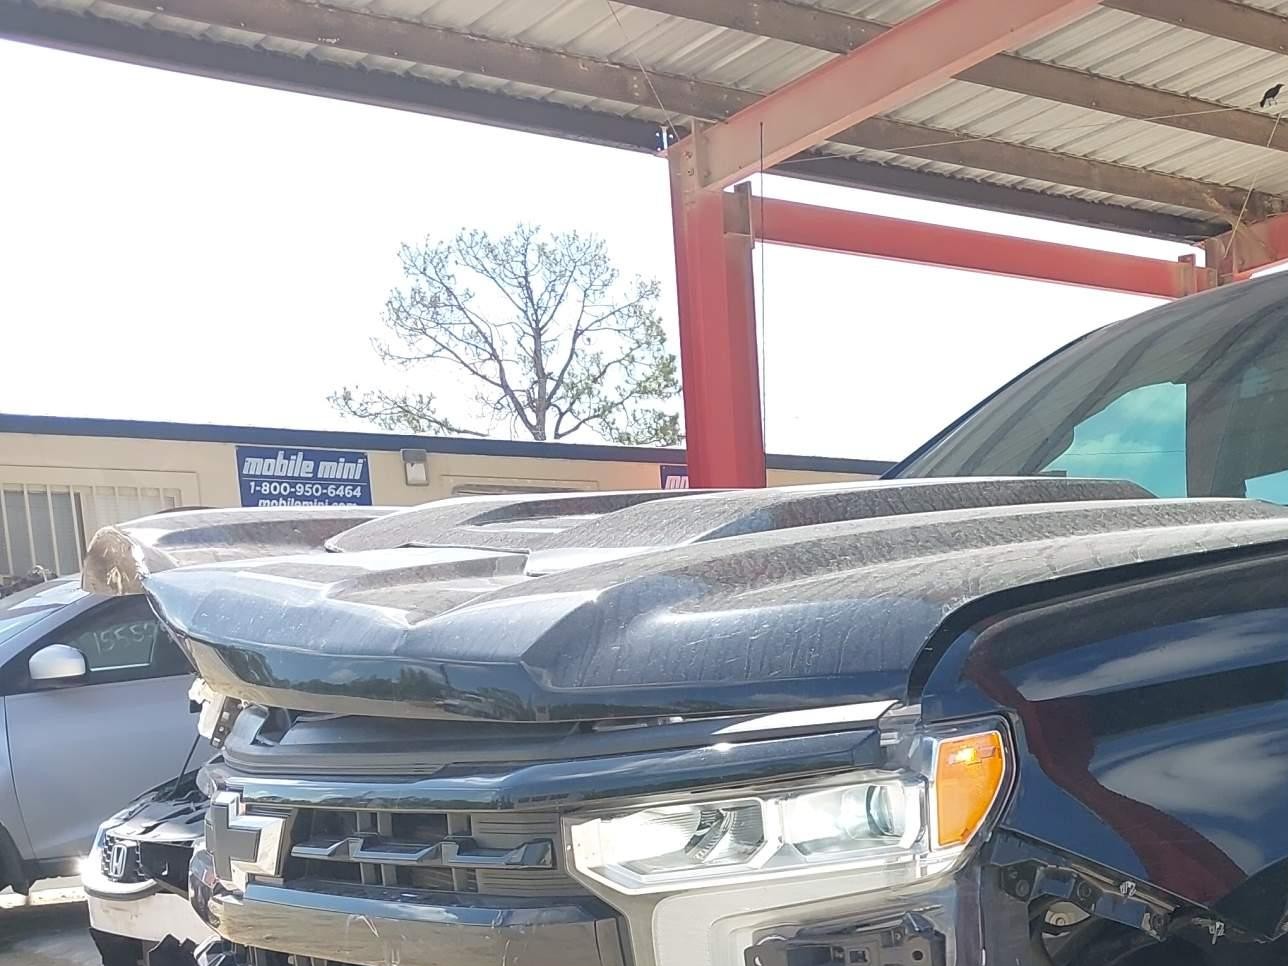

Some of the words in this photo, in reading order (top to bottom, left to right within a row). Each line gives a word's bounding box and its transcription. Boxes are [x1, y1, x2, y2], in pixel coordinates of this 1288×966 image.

[242, 450, 315, 478] mobile
[317, 457, 364, 480] mini
[249, 481, 362, 498] 1-800-950-6464
